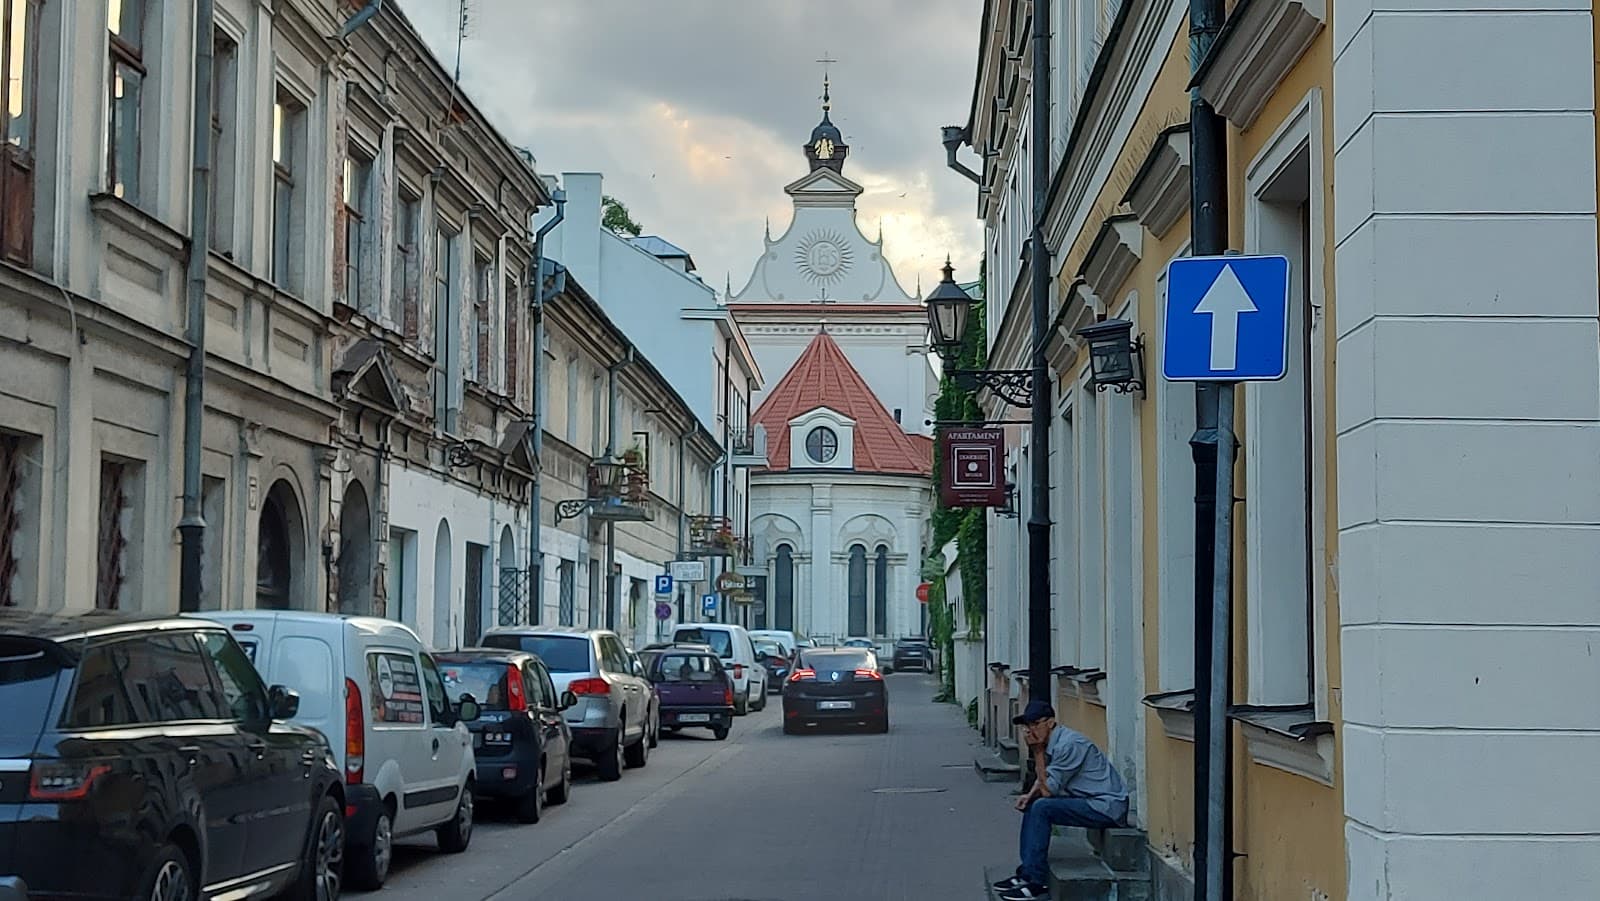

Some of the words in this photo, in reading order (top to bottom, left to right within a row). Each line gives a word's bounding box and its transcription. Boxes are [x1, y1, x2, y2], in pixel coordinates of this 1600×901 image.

[947, 432, 1000, 440] APARTAMENT
[659, 578, 669, 591] P
[705, 597, 714, 607] P
